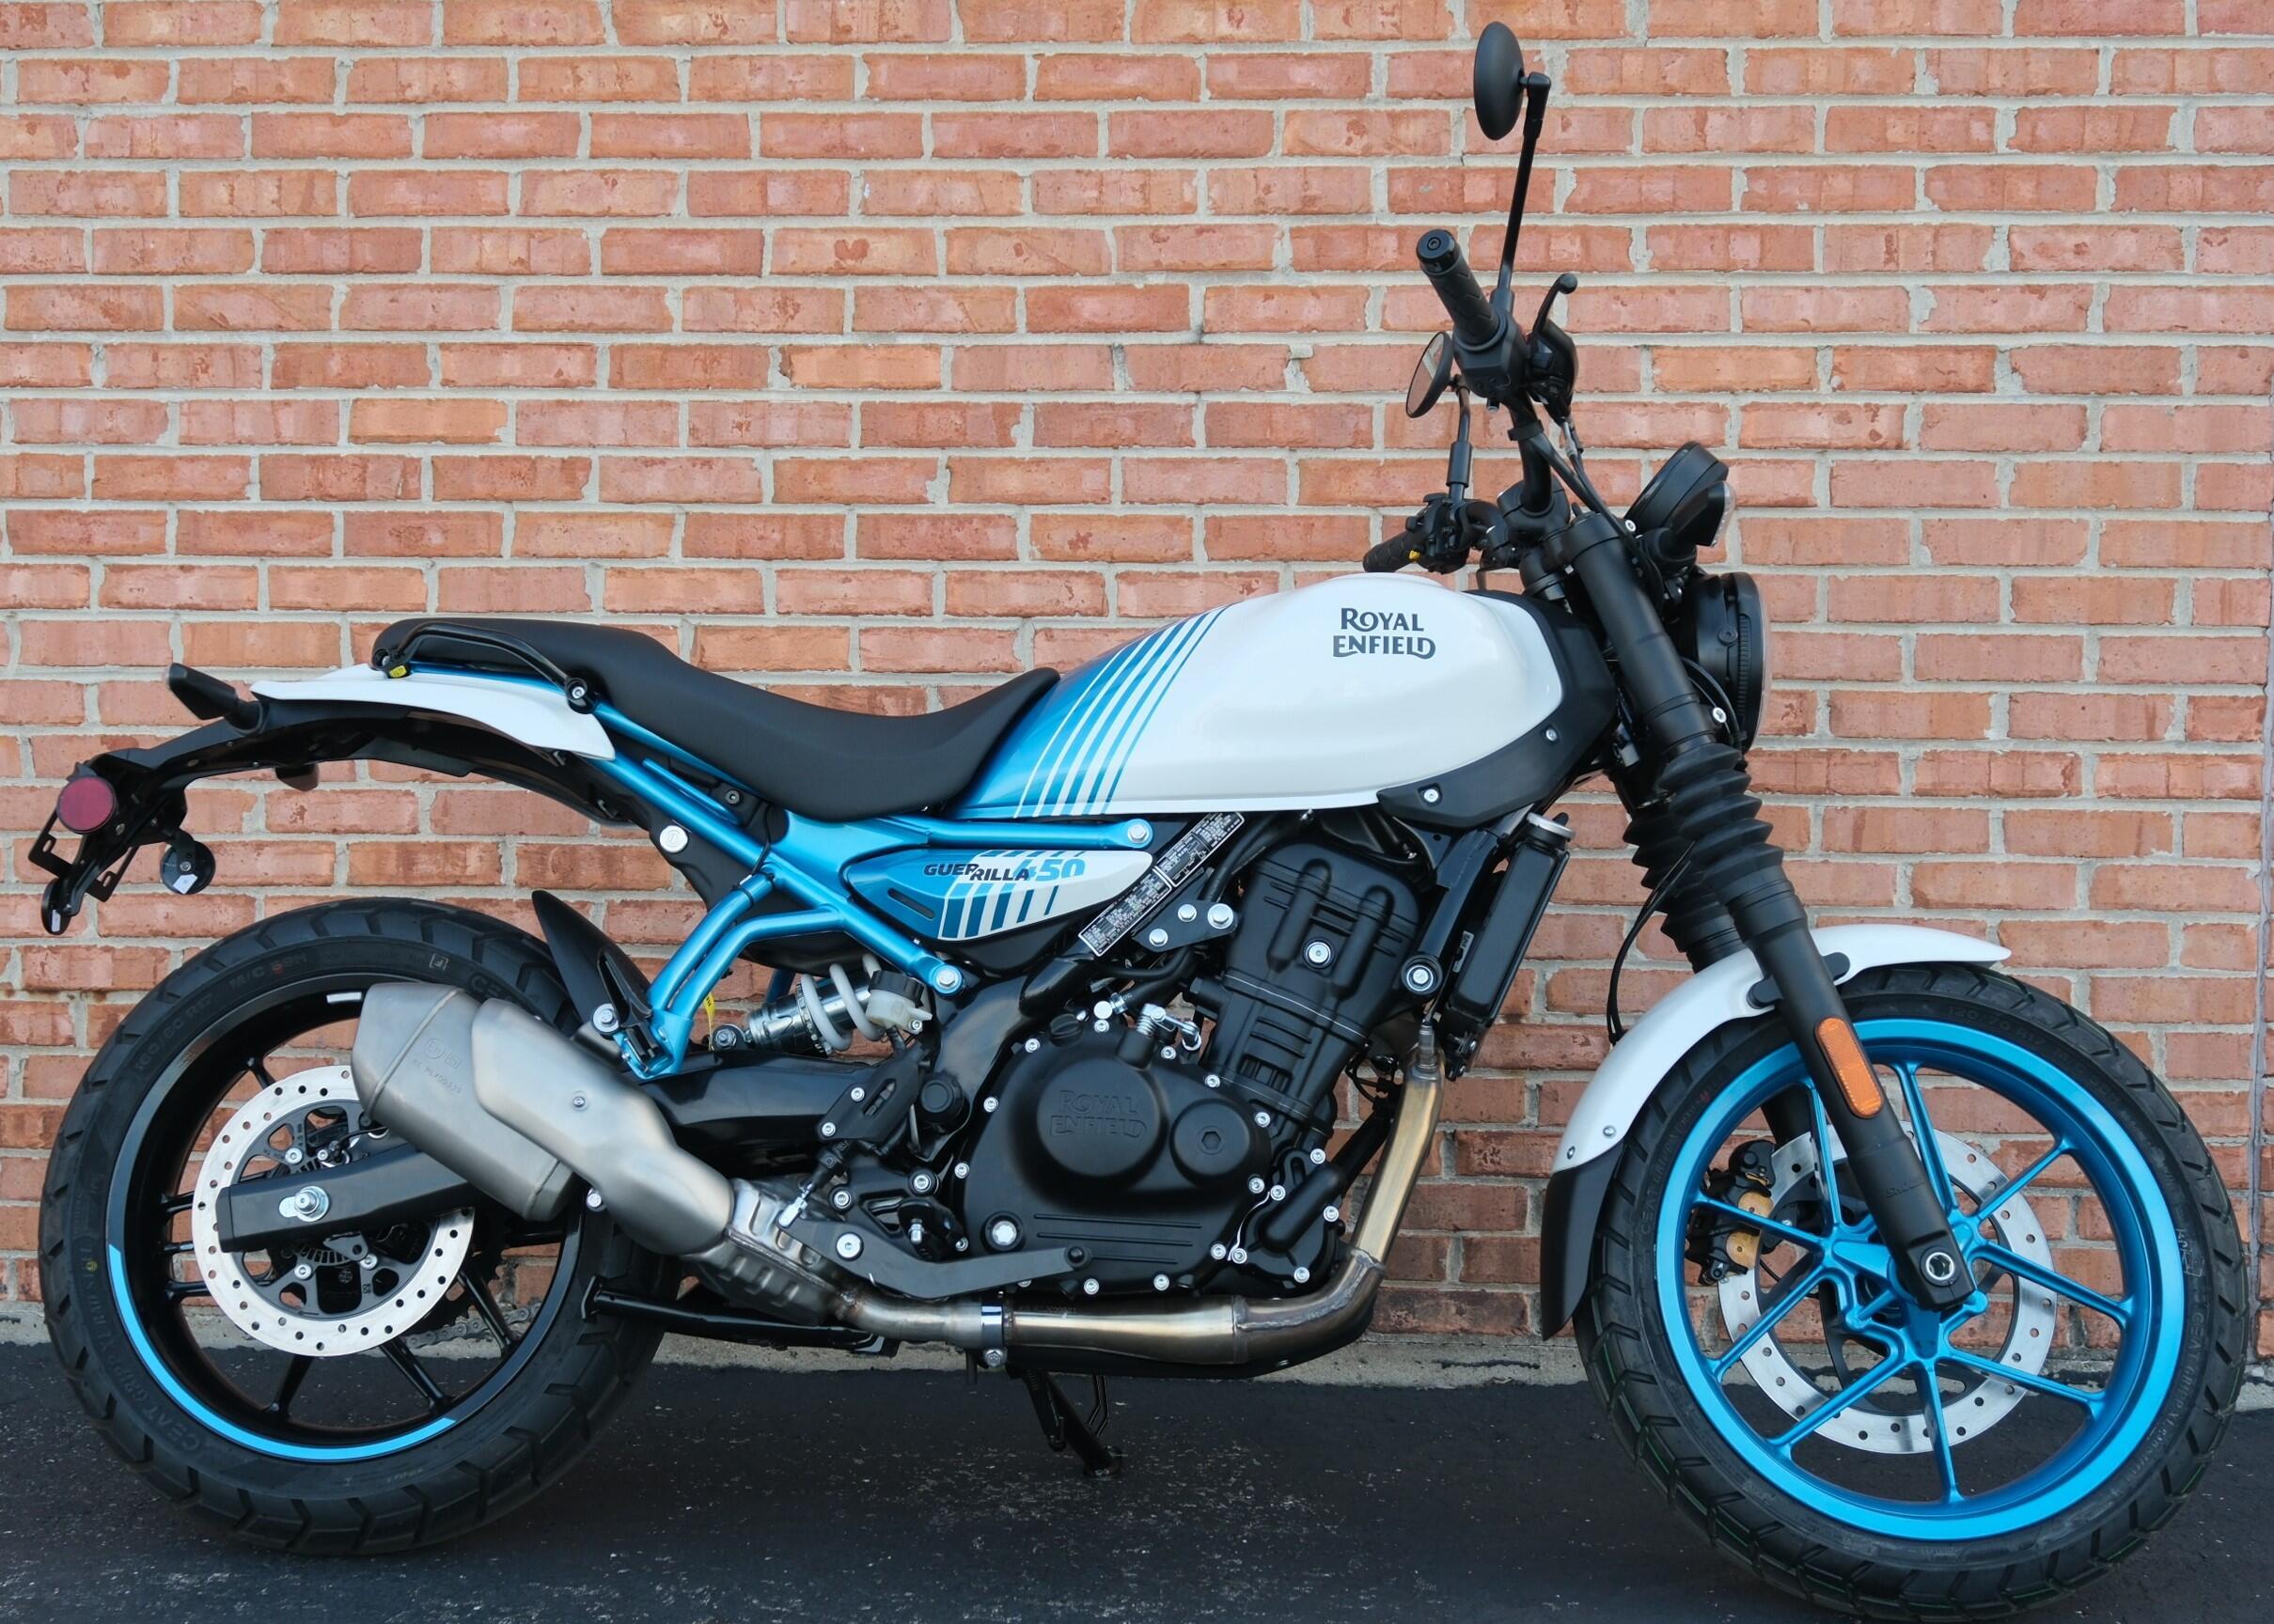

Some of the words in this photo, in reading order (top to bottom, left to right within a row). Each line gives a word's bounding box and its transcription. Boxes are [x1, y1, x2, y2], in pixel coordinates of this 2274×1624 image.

[1341, 607, 1424, 632] ROYAL
[1332, 635, 1436, 660] ENFIELD
[923, 863, 1029, 882] GUERRILLA
[1059, 1090, 1138, 1115] ROYAL
[1050, 1116, 1148, 1139] ENFIELD
[1640, 1188, 1658, 1235] CEAT
[2187, 1310, 2204, 1361] CEAT
[145, 1401, 202, 1454] CEAT
